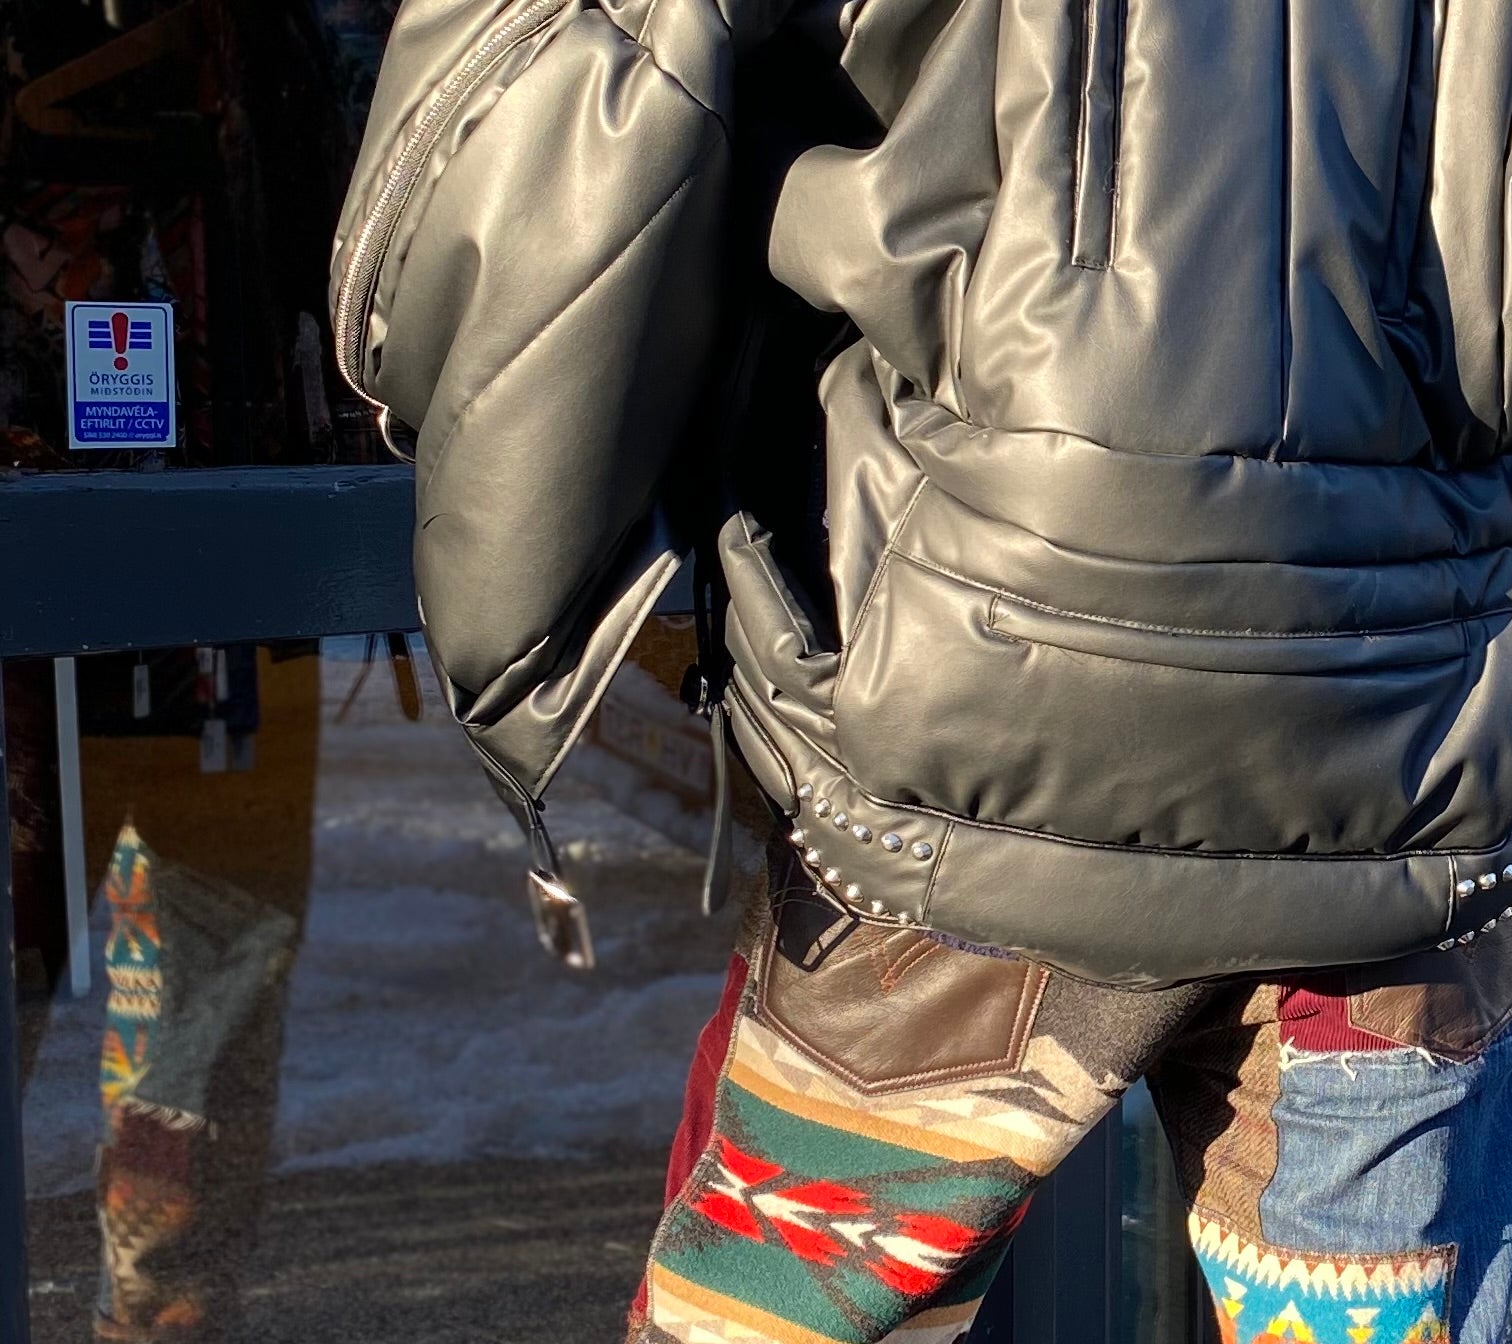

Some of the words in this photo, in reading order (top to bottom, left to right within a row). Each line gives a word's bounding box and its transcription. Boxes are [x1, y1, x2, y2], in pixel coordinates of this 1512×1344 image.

[89, 372, 154, 385] ÖRYGGIS
[85, 406, 158, 416] MYNDAVÉLA-
[80, 419, 126, 429] EFTIRLIT
[135, 419, 165, 429] CCTV
